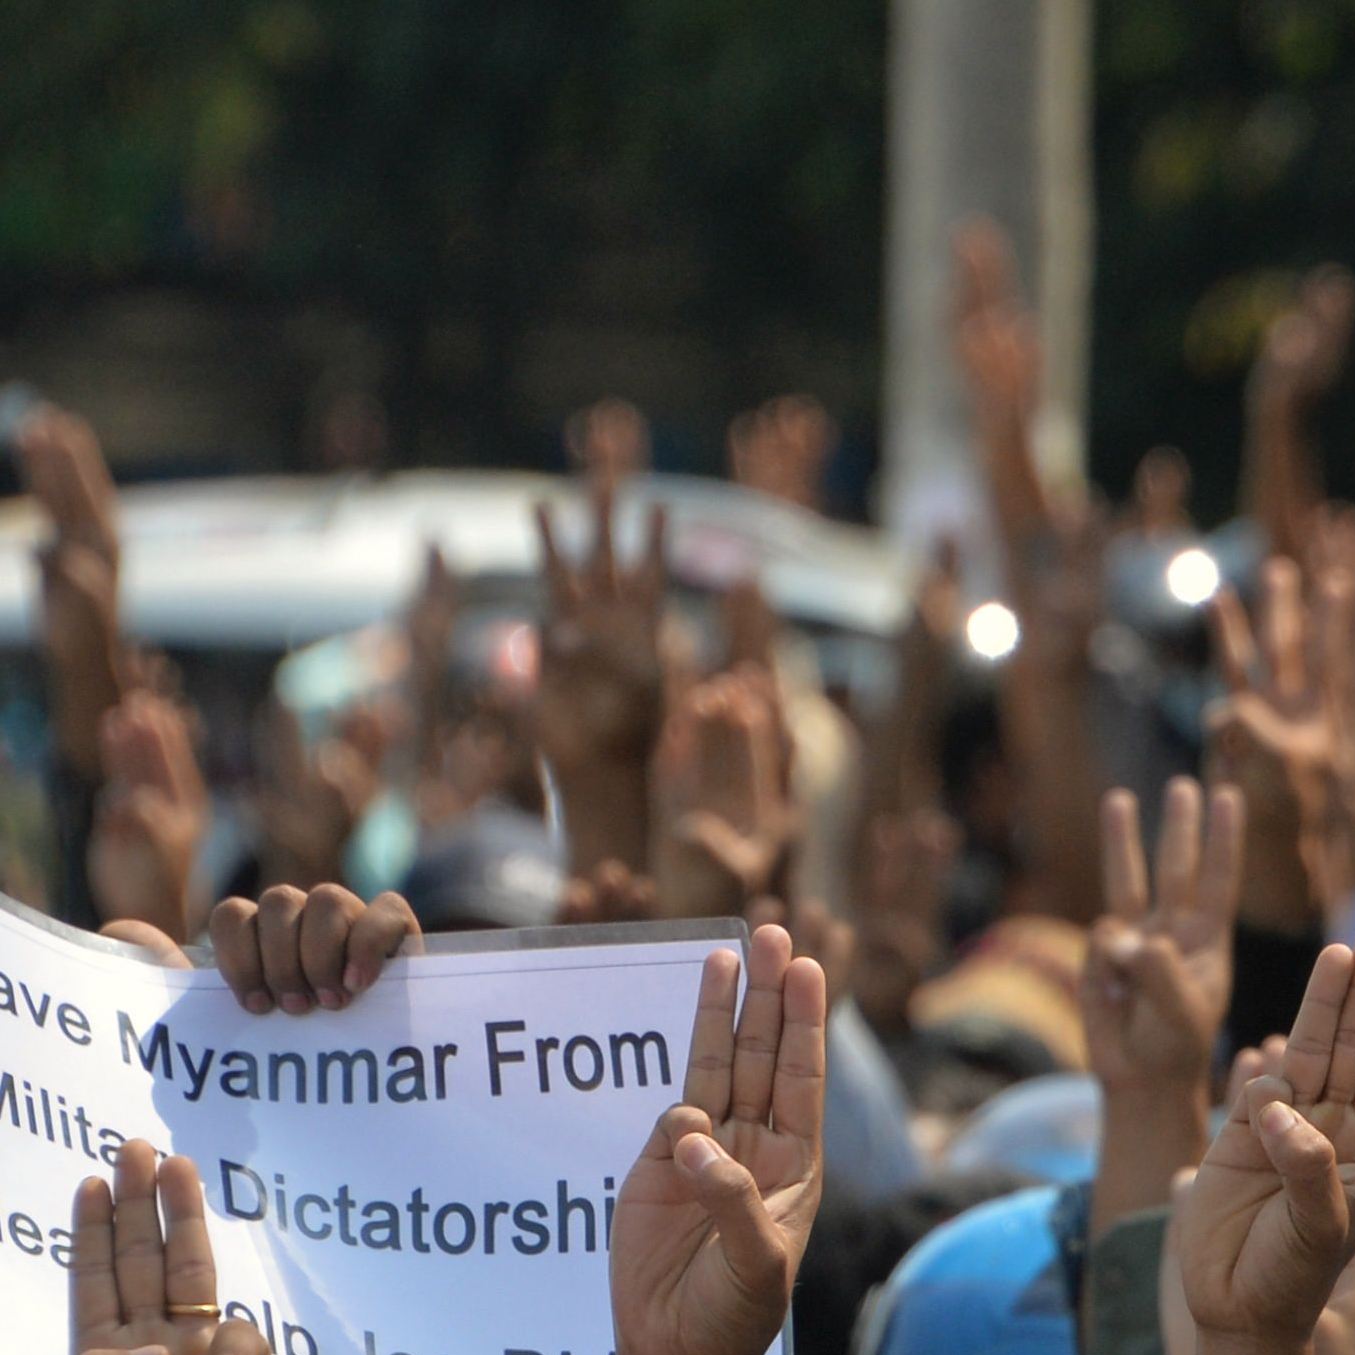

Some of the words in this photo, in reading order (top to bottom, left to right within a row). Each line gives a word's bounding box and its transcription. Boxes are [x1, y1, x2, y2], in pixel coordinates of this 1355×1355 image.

[0, 971, 92, 1046] ave
[116, 1010, 457, 1104] Myanmar
[485, 1020, 672, 1096] From
[220, 1158, 614, 1256] Dictatorshi
